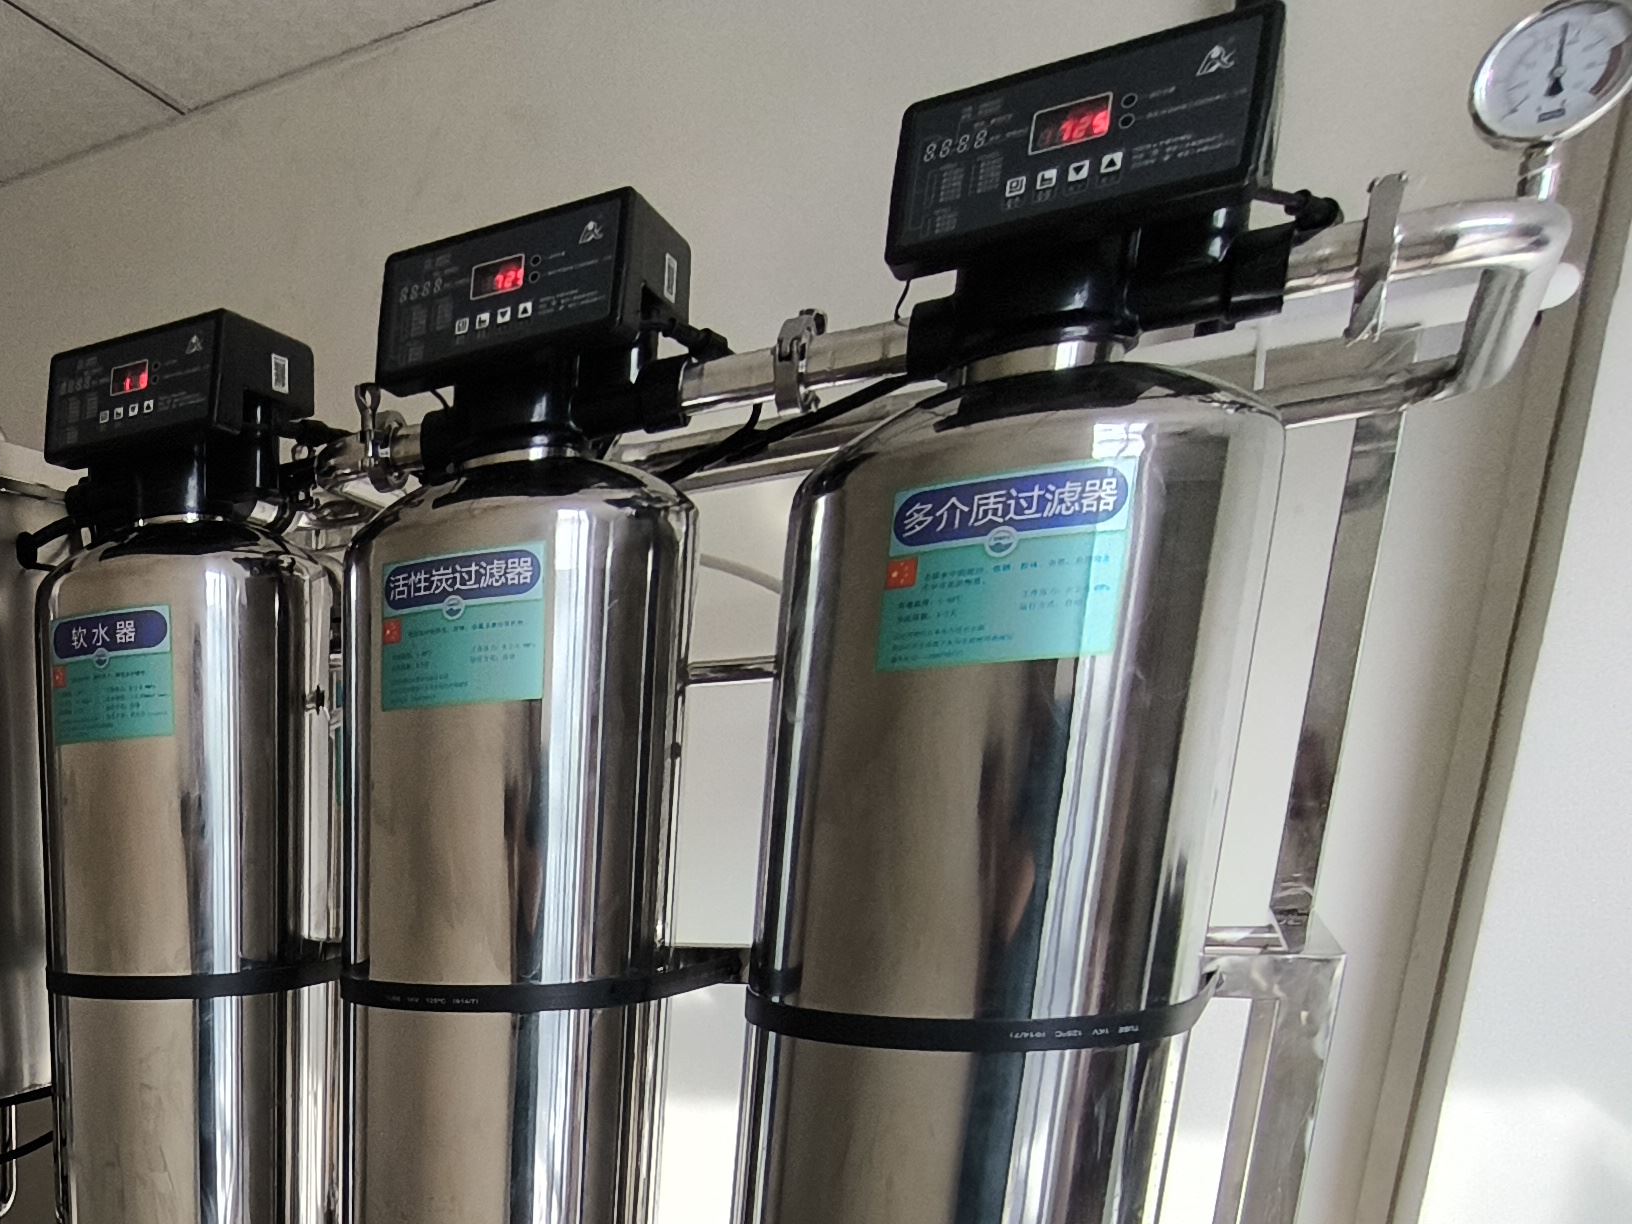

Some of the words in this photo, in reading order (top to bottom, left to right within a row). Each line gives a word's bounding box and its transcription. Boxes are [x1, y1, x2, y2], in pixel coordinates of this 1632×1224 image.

[902, 477, 1118, 538] 多介质过滤器
[389, 557, 533, 601] 活性炭过滤器
[72, 620, 135, 650] 软水器
